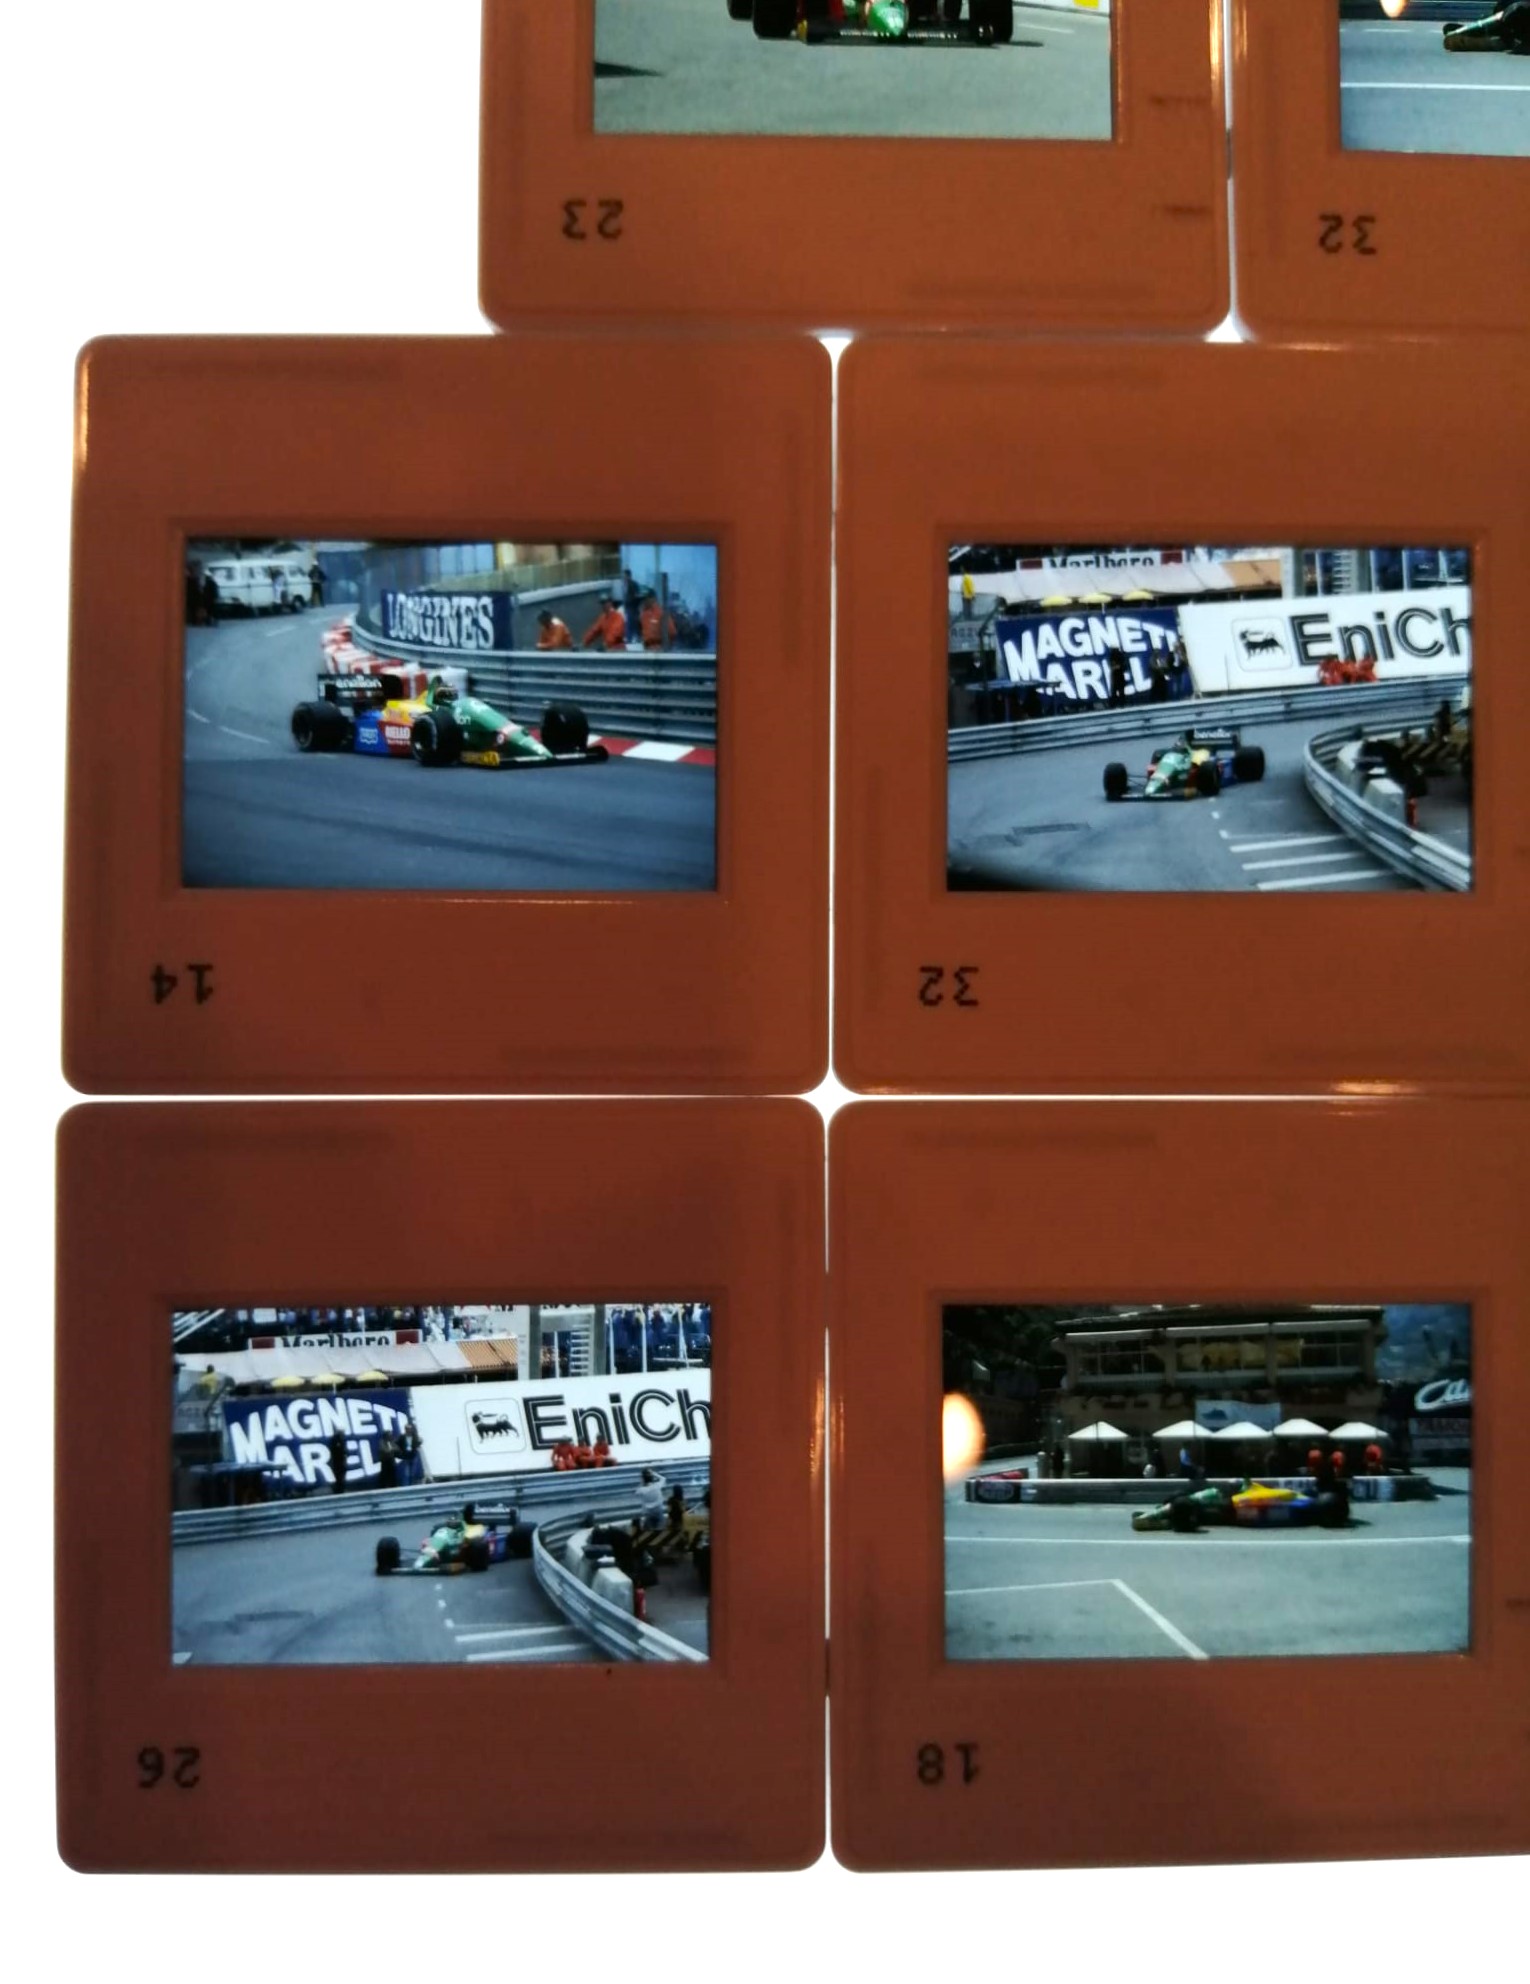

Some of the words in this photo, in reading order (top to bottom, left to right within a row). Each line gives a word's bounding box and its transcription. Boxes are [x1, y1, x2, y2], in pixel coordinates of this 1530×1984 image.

[561, 198, 624, 240] 23
[1317, 213, 1377, 255] 32
[386, 592, 495, 650] LONGINES
[150, 963, 213, 1004] 14
[917, 965, 979, 1007] 32
[137, 1746, 200, 1788] 26
[916, 1742, 981, 1784] 18
